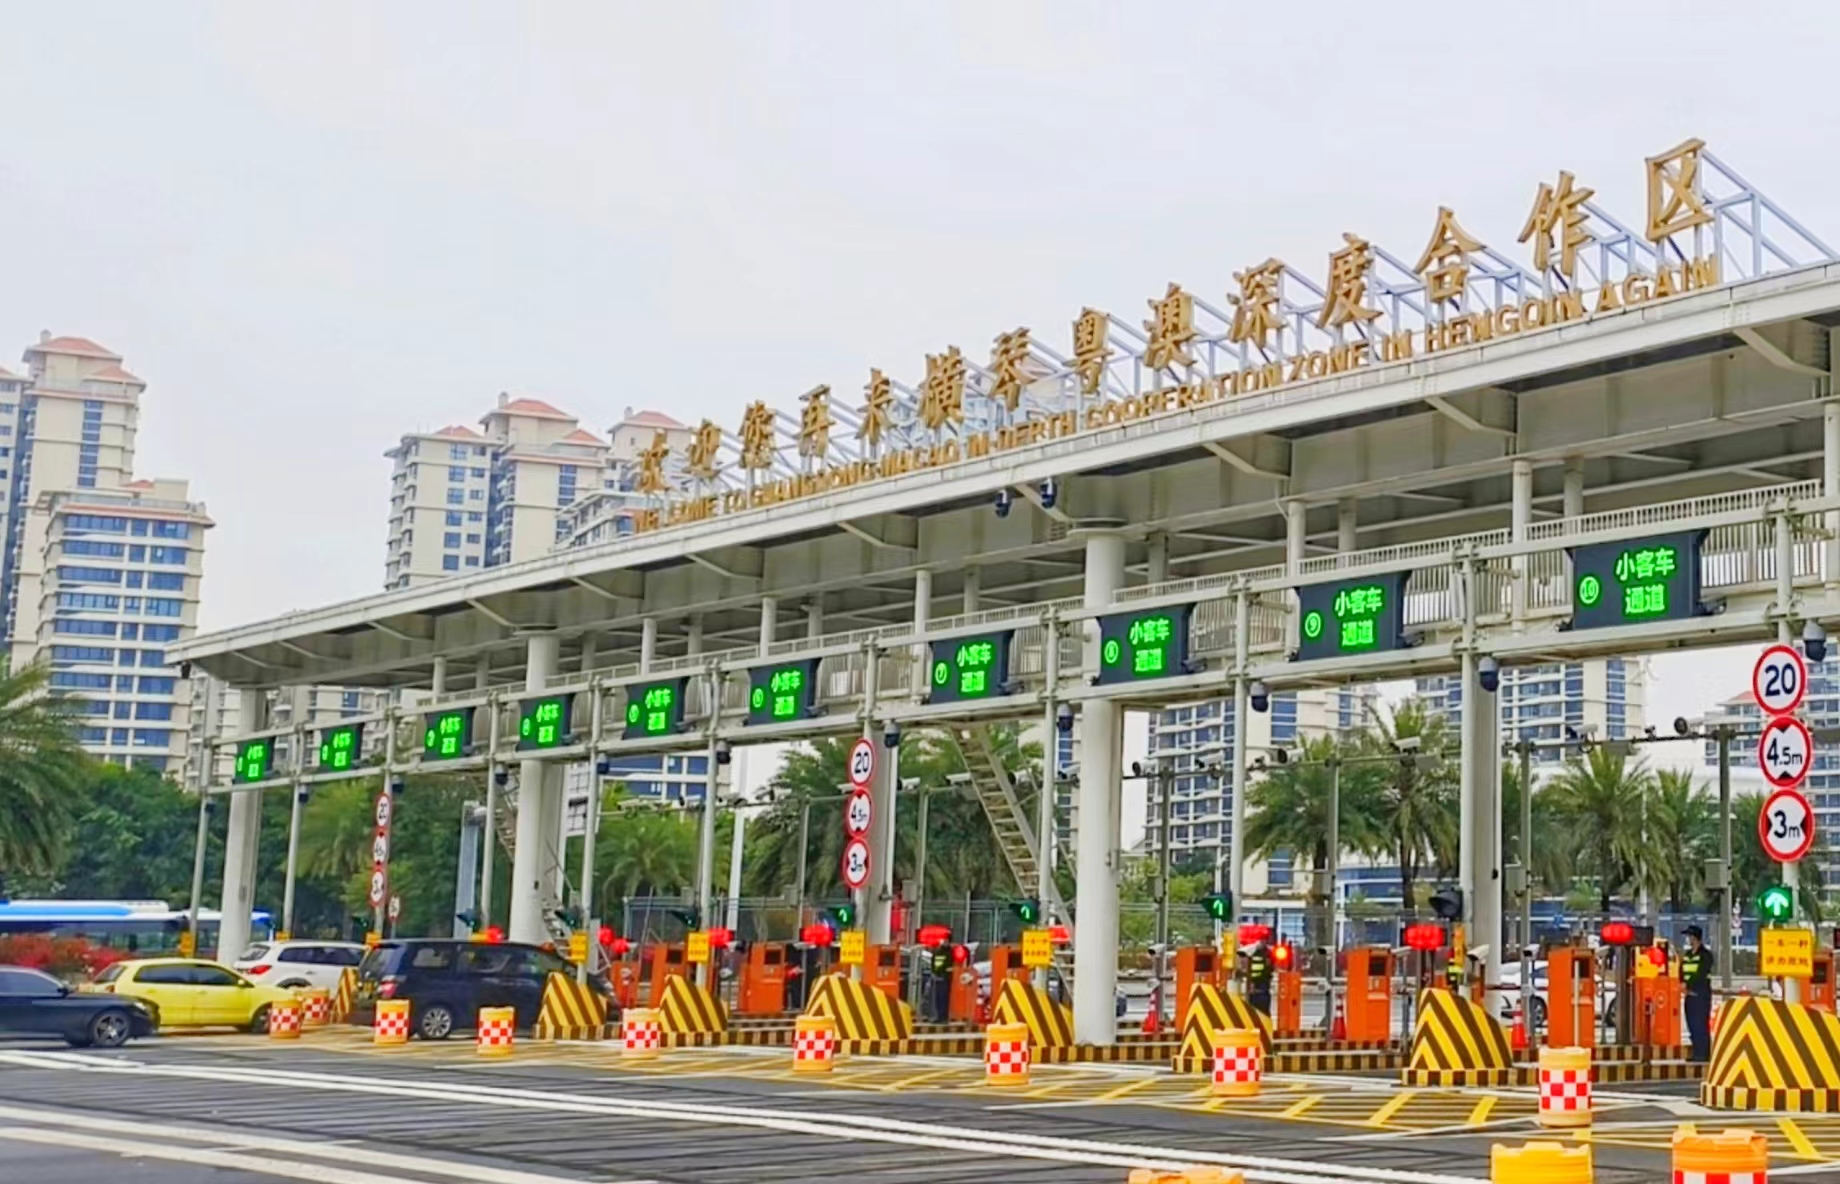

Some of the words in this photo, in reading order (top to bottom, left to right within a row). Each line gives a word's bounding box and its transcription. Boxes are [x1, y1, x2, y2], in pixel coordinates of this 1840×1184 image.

[1288, 340, 1370, 383] ZONE
[1382, 327, 1413, 363] IN
[1597, 253, 1719, 313] AGAIN
[1616, 548, 1675, 581] 小客车
[1335, 587, 1382, 616] 小客车
[1625, 584, 1665, 614] 通道
[1130, 618, 1170, 644] 小客车
[1342, 619, 1373, 647] 通道
[957, 643, 991, 667] 小客车
[1765, 662, 1797, 696] 20
[854, 752, 869, 774] 20
[1767, 737, 1803, 766] 4.5m
[1773, 809, 1801, 839] 3m
